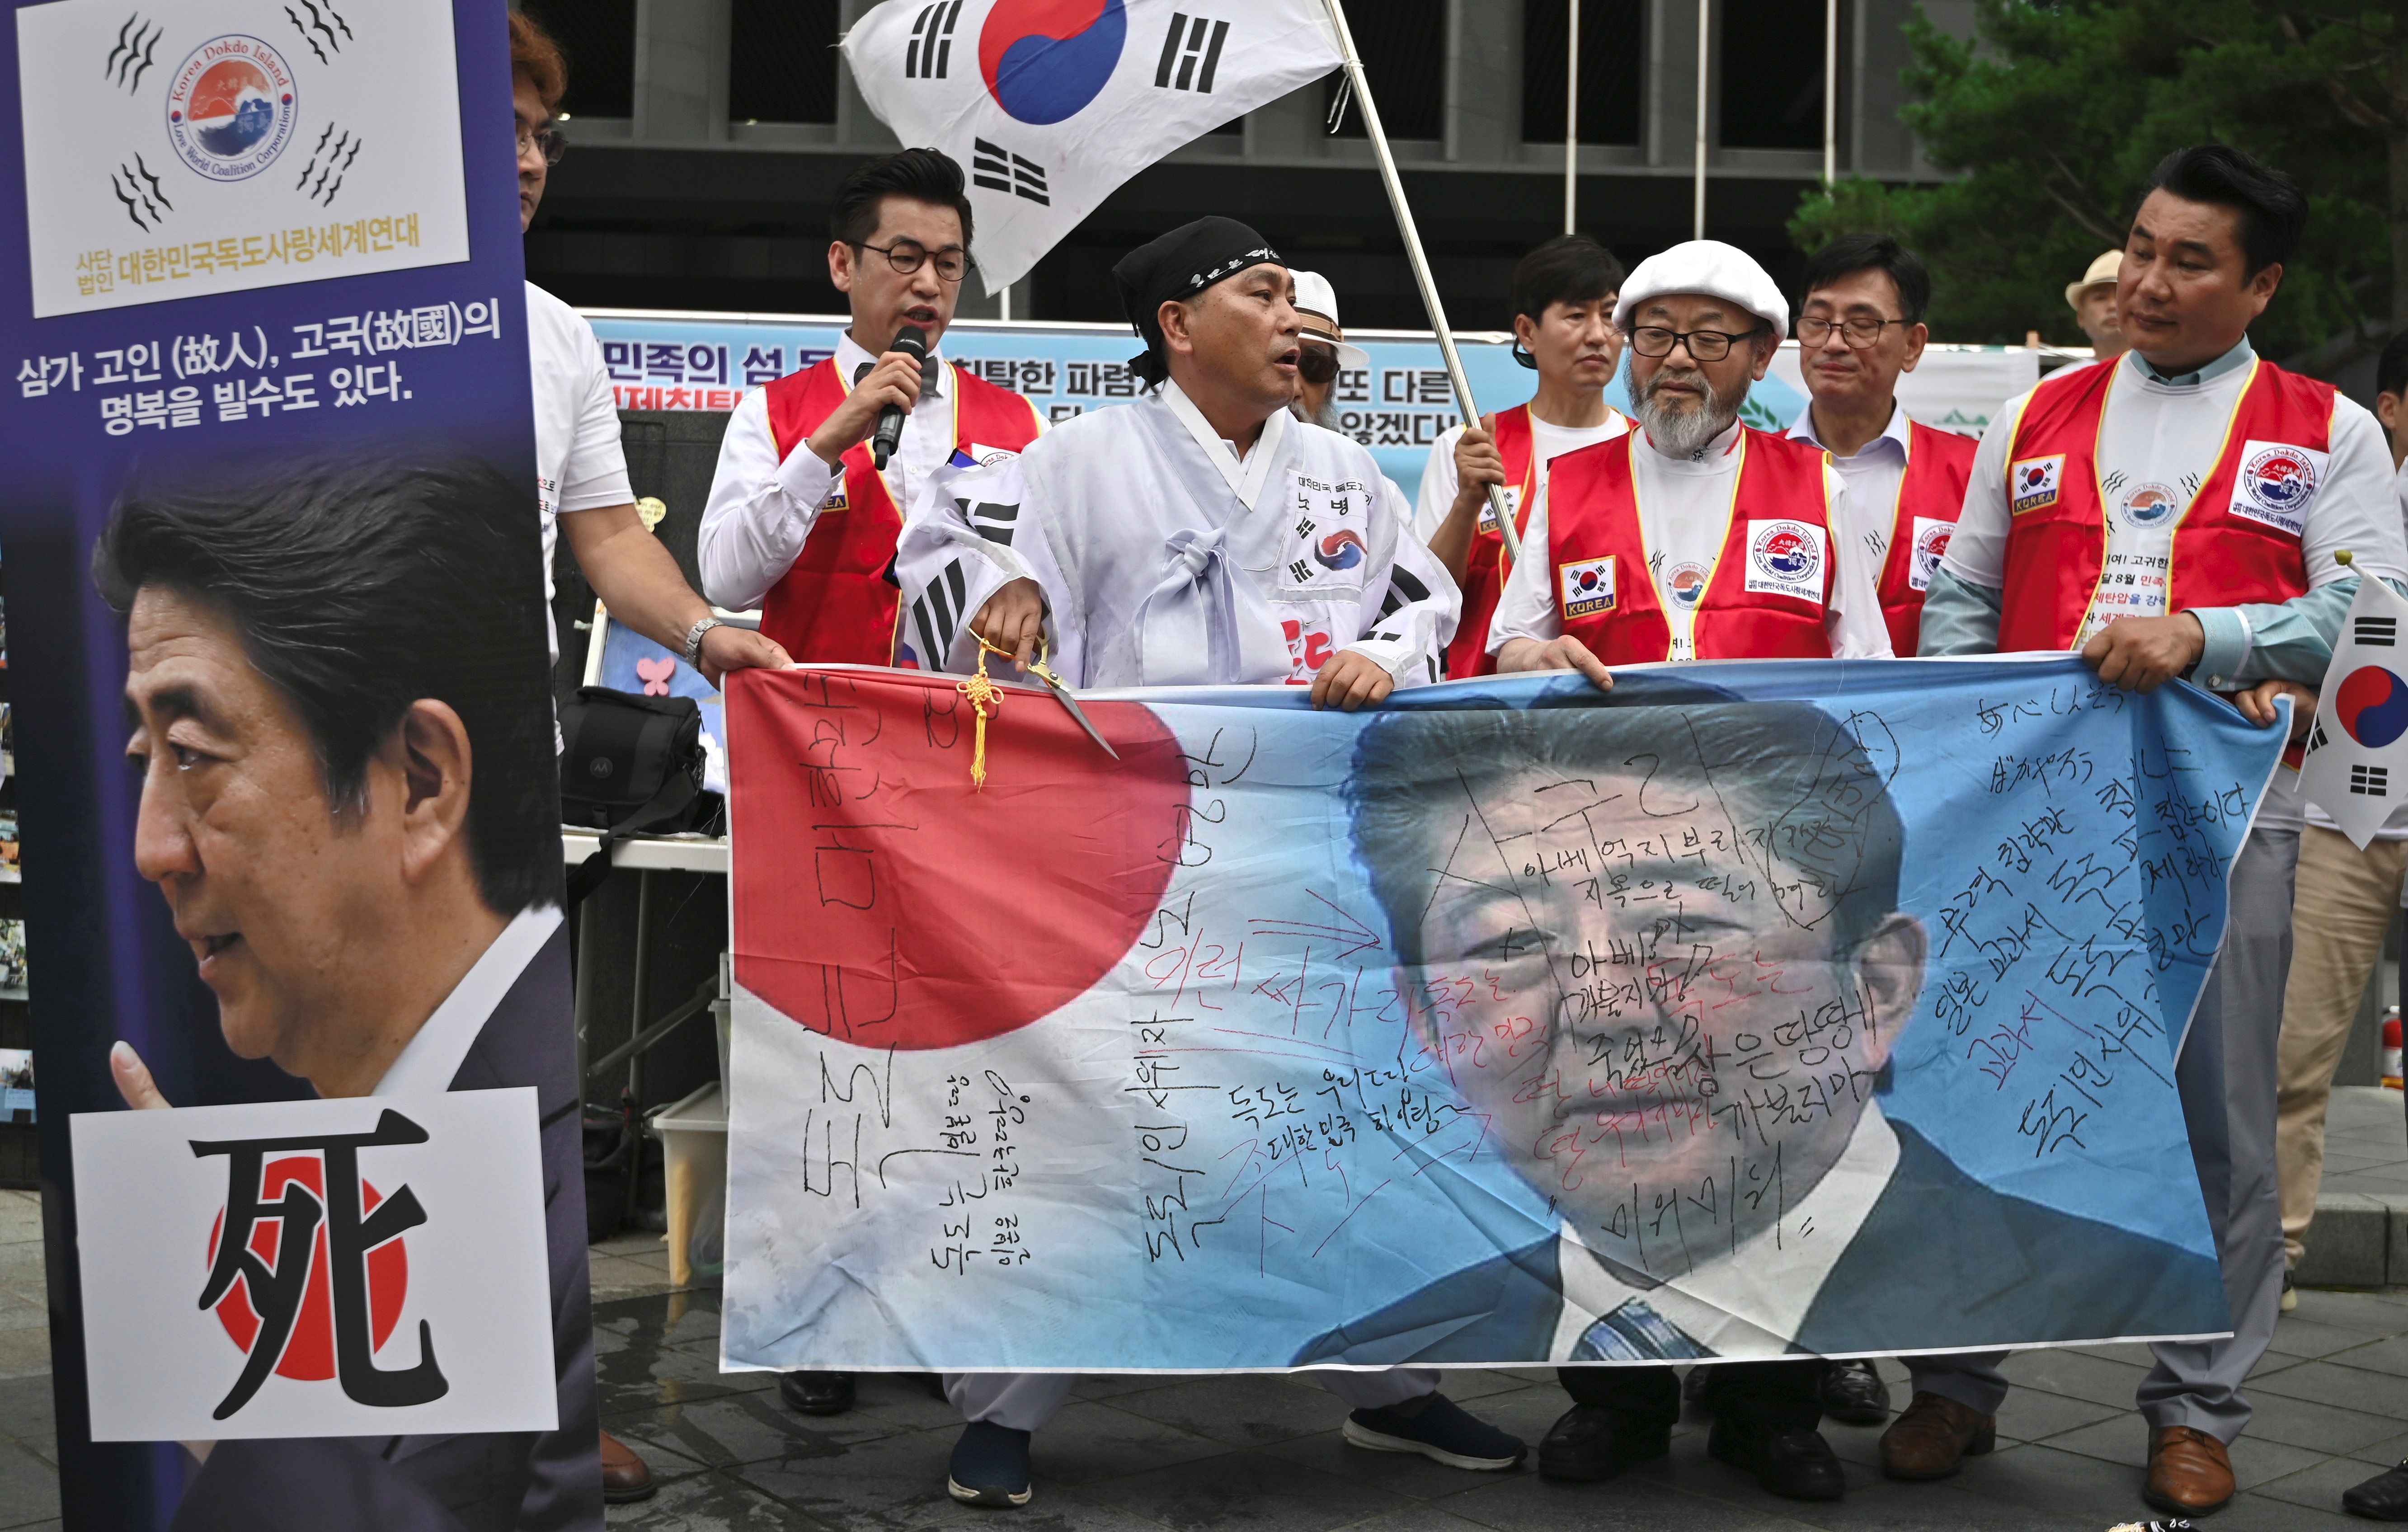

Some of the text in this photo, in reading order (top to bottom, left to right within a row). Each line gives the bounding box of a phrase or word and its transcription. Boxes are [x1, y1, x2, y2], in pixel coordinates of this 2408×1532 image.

[173, 40, 289, 103] Korea Dokdo Island
[173, 107, 291, 177] Love World Coalition Corporation
[76, 248, 113, 271] 사단
[118, 212, 420, 286] 대한민국독도사랑세계연대
[78, 271, 115, 296] 법인
[16, 352, 84, 399] 삼가
[92, 340, 162, 385] 고인
[603, 341, 728, 386] 민족의
[99, 360, 413, 437] 명복을 빌수도 있다.
[1298, 476, 1332, 493] 대한민국
[2249, 449, 2314, 482] Korea Dokdo Island
[1331, 496, 1349, 516] 병
[2014, 492, 2057, 514] KOREA
[1756, 524, 1817, 554] Korea Dokdo Island
[1566, 597, 1614, 616] KOREA
[1228, 1081, 1305, 1133] 독도는
[931, 1172, 987, 1276] 독도는
[990, 1212, 1031, 1266] 일본은
[187, 1107, 451, 1422] 死
